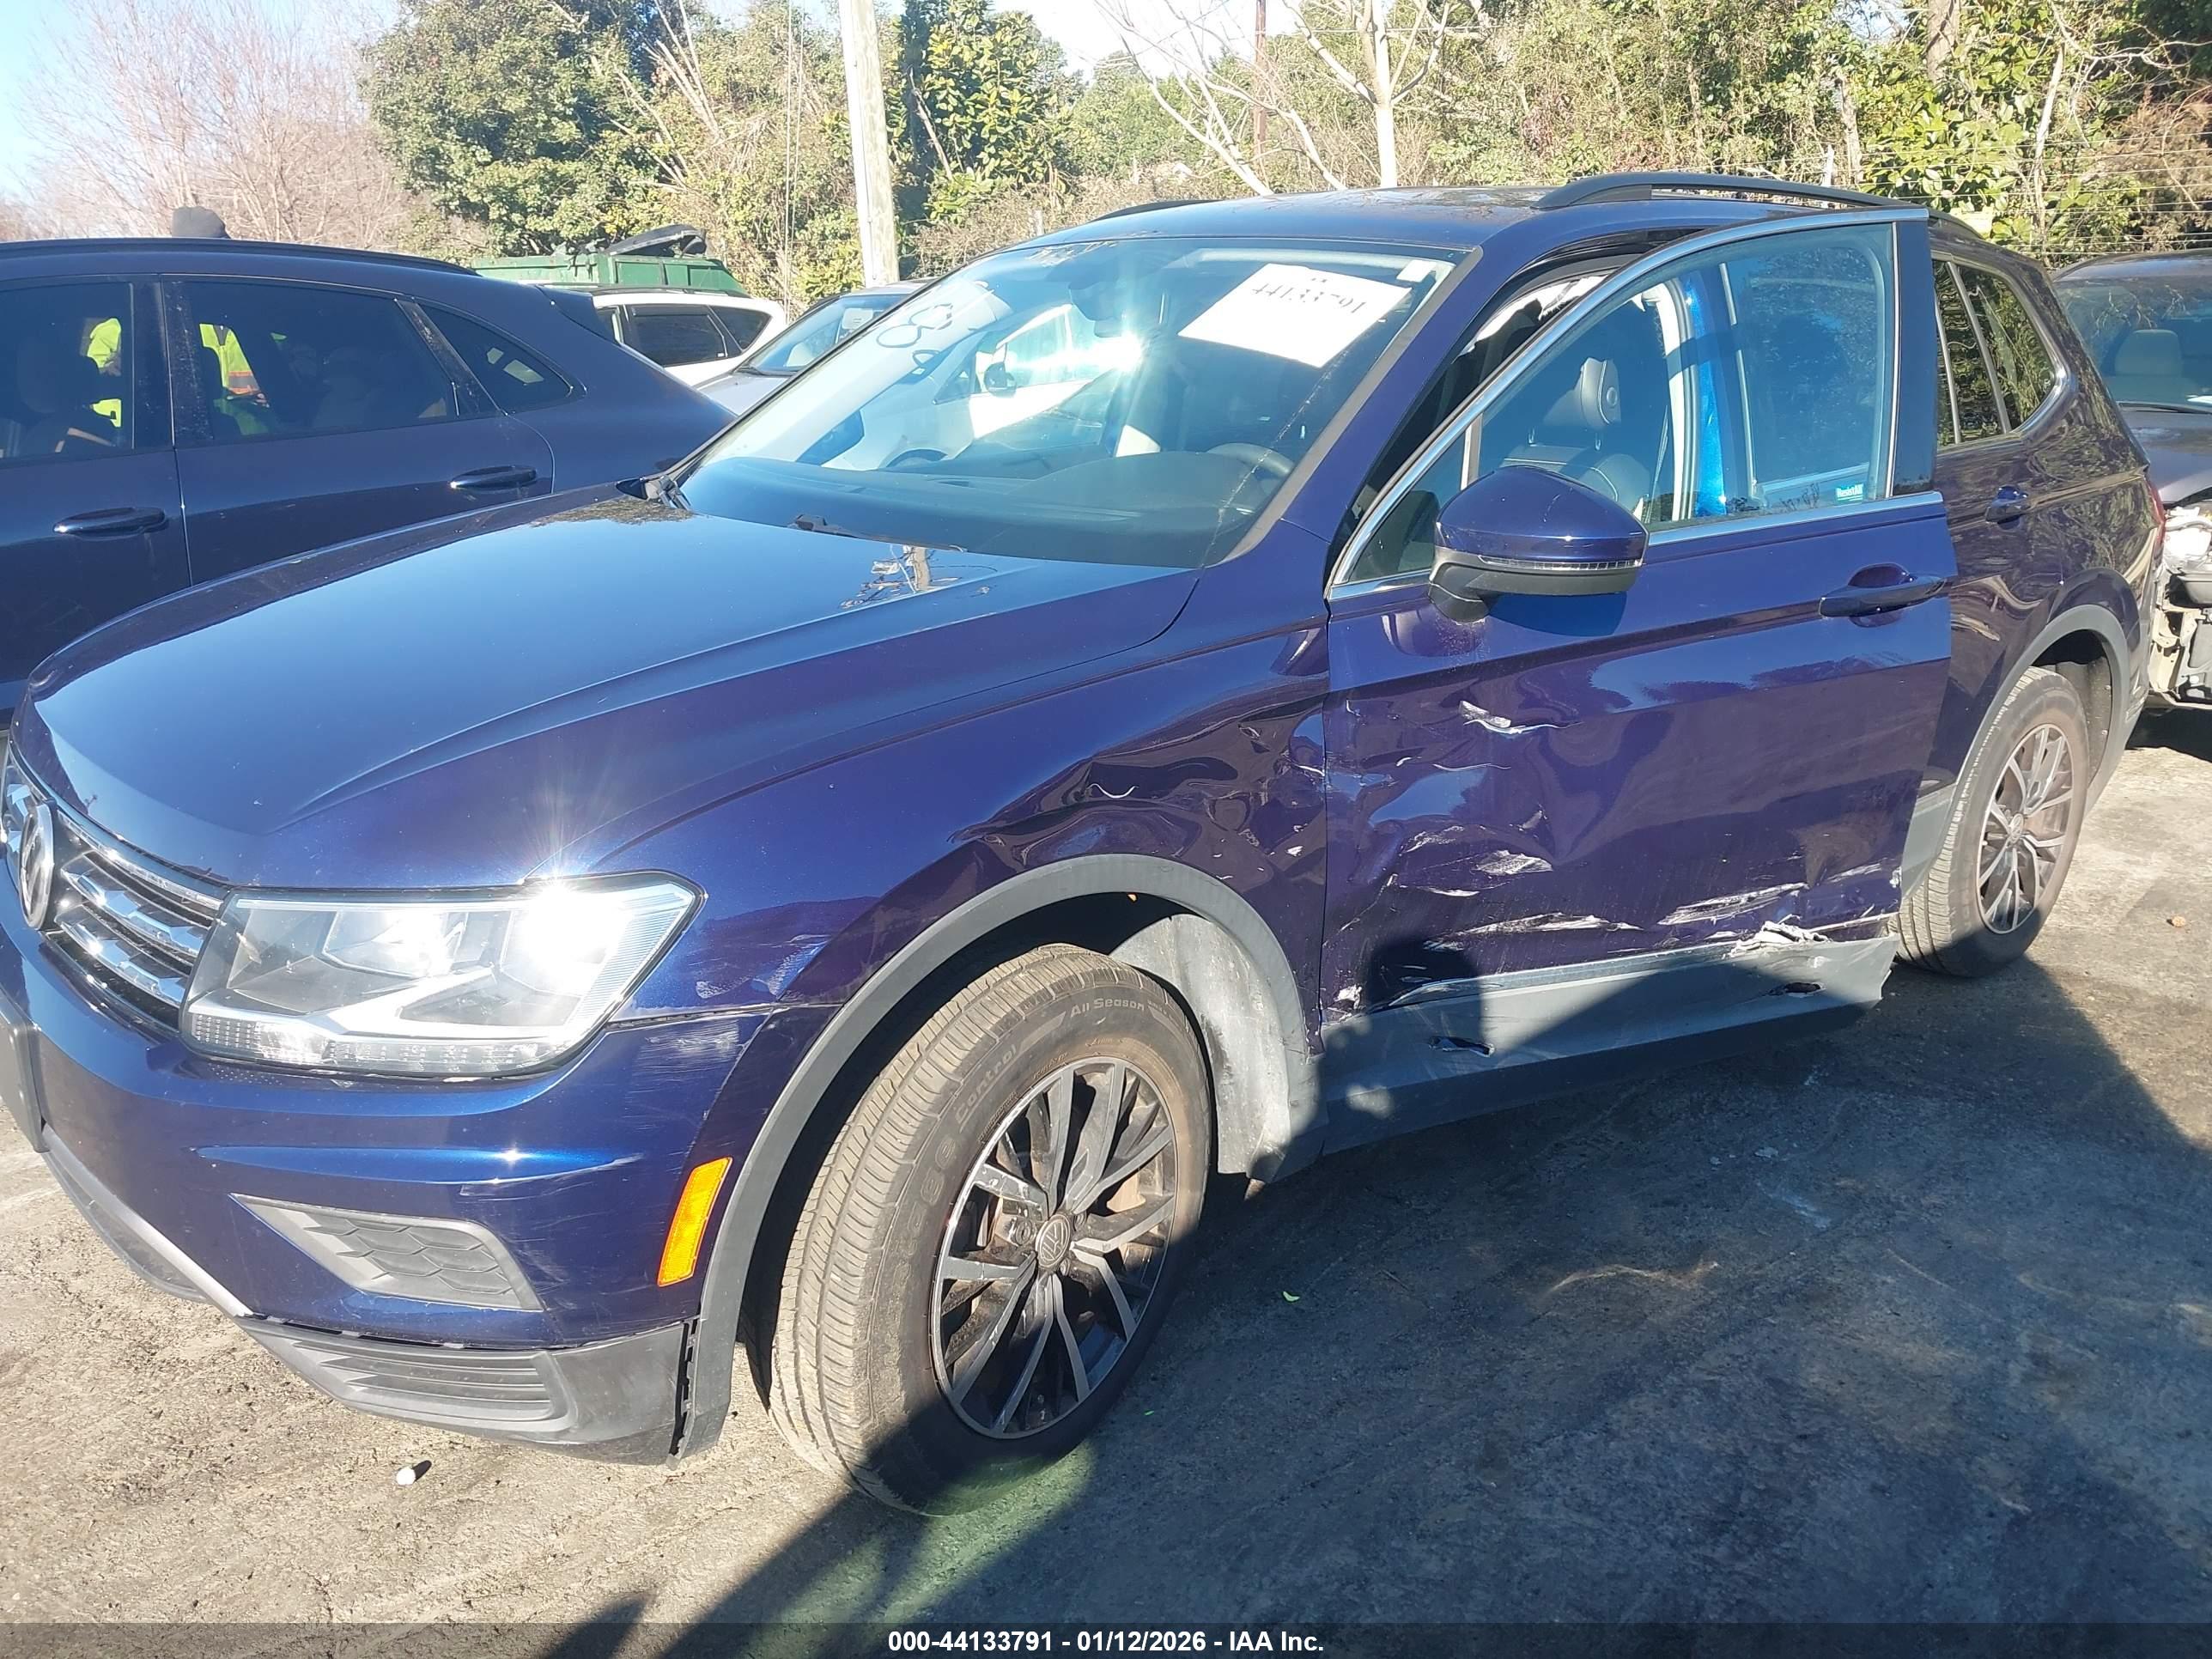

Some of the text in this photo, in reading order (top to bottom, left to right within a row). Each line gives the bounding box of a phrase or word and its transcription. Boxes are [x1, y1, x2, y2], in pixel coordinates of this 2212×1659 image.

[953, 1043, 1018, 1124] Control
[1070, 1001, 1091, 1018] All
[1093, 997, 1146, 1012] Season
